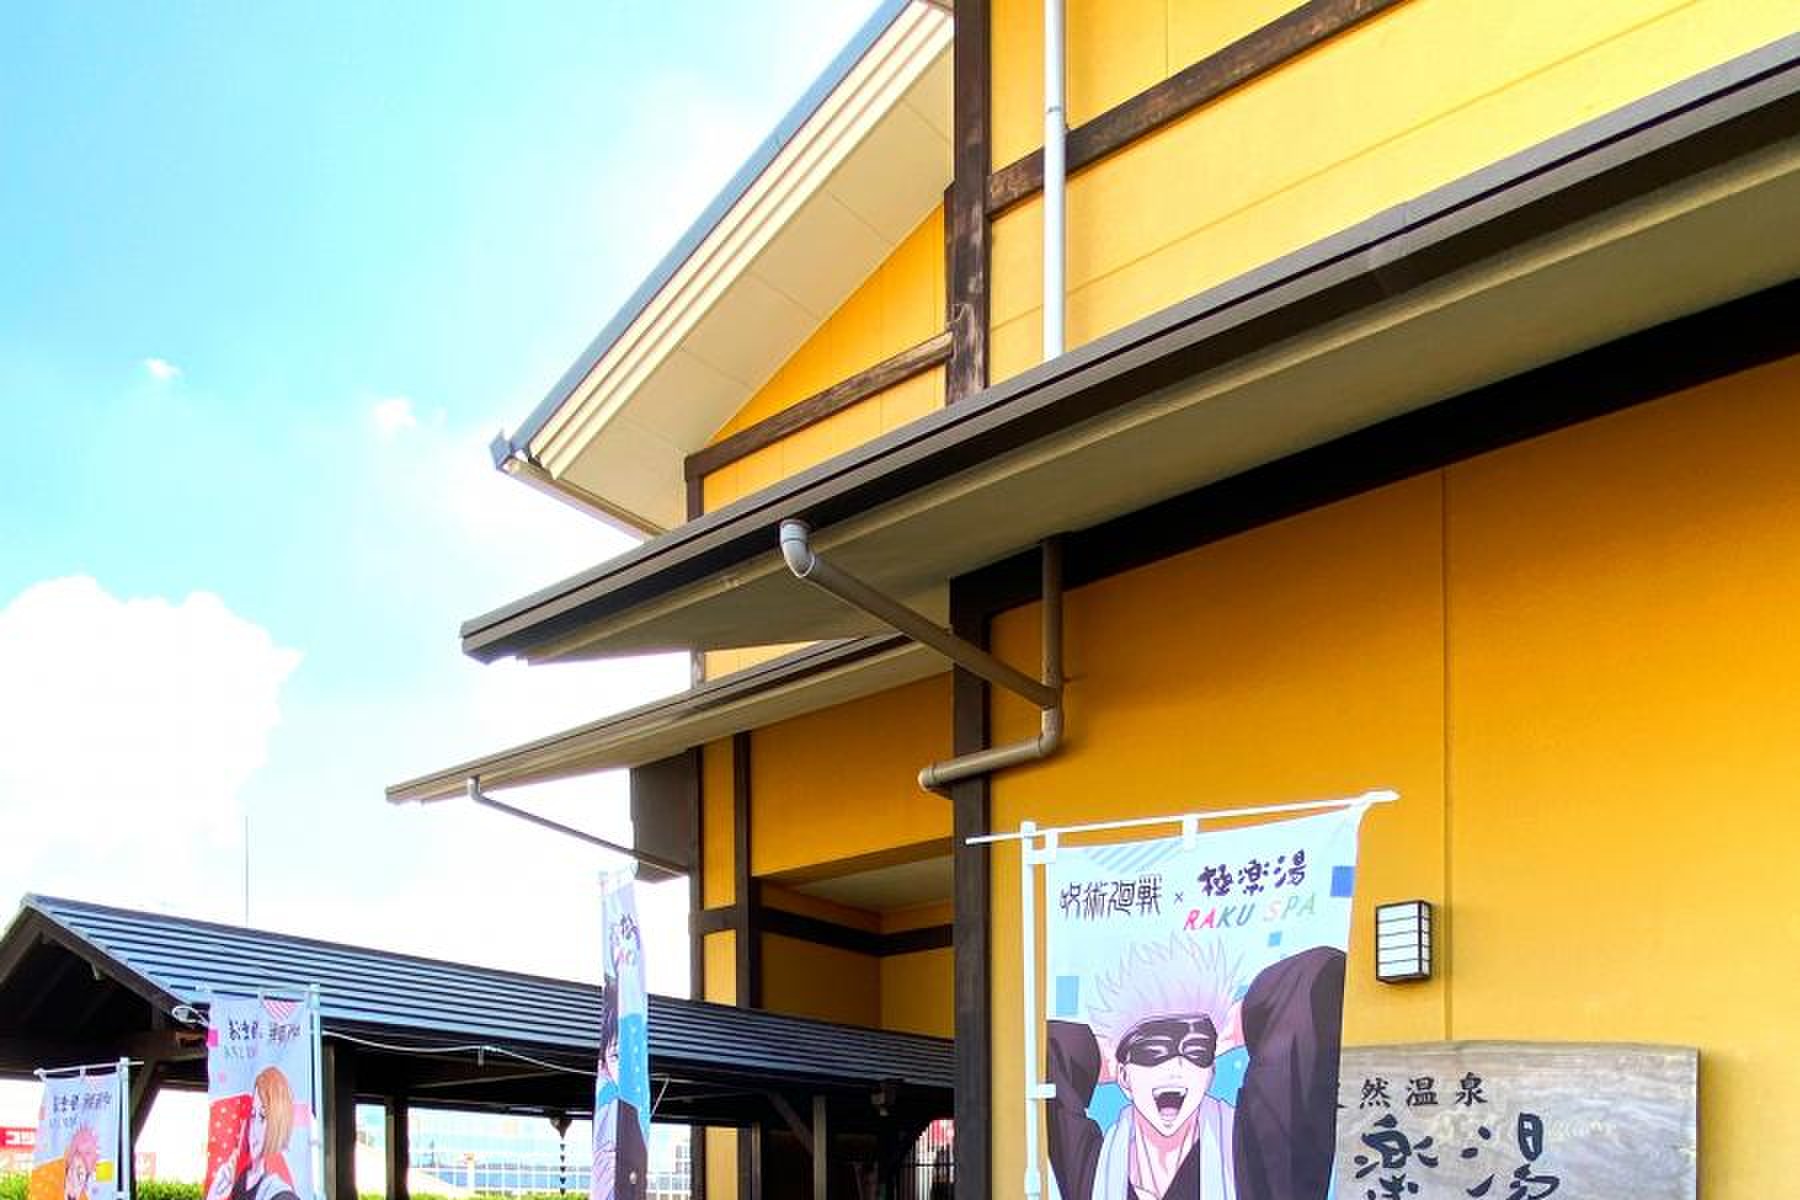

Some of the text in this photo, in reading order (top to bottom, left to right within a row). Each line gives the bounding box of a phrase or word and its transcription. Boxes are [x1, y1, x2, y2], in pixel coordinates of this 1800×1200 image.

[1198, 849, 1306, 897] 極楽湯
[1184, 892, 1316, 930] RAKU SPA
